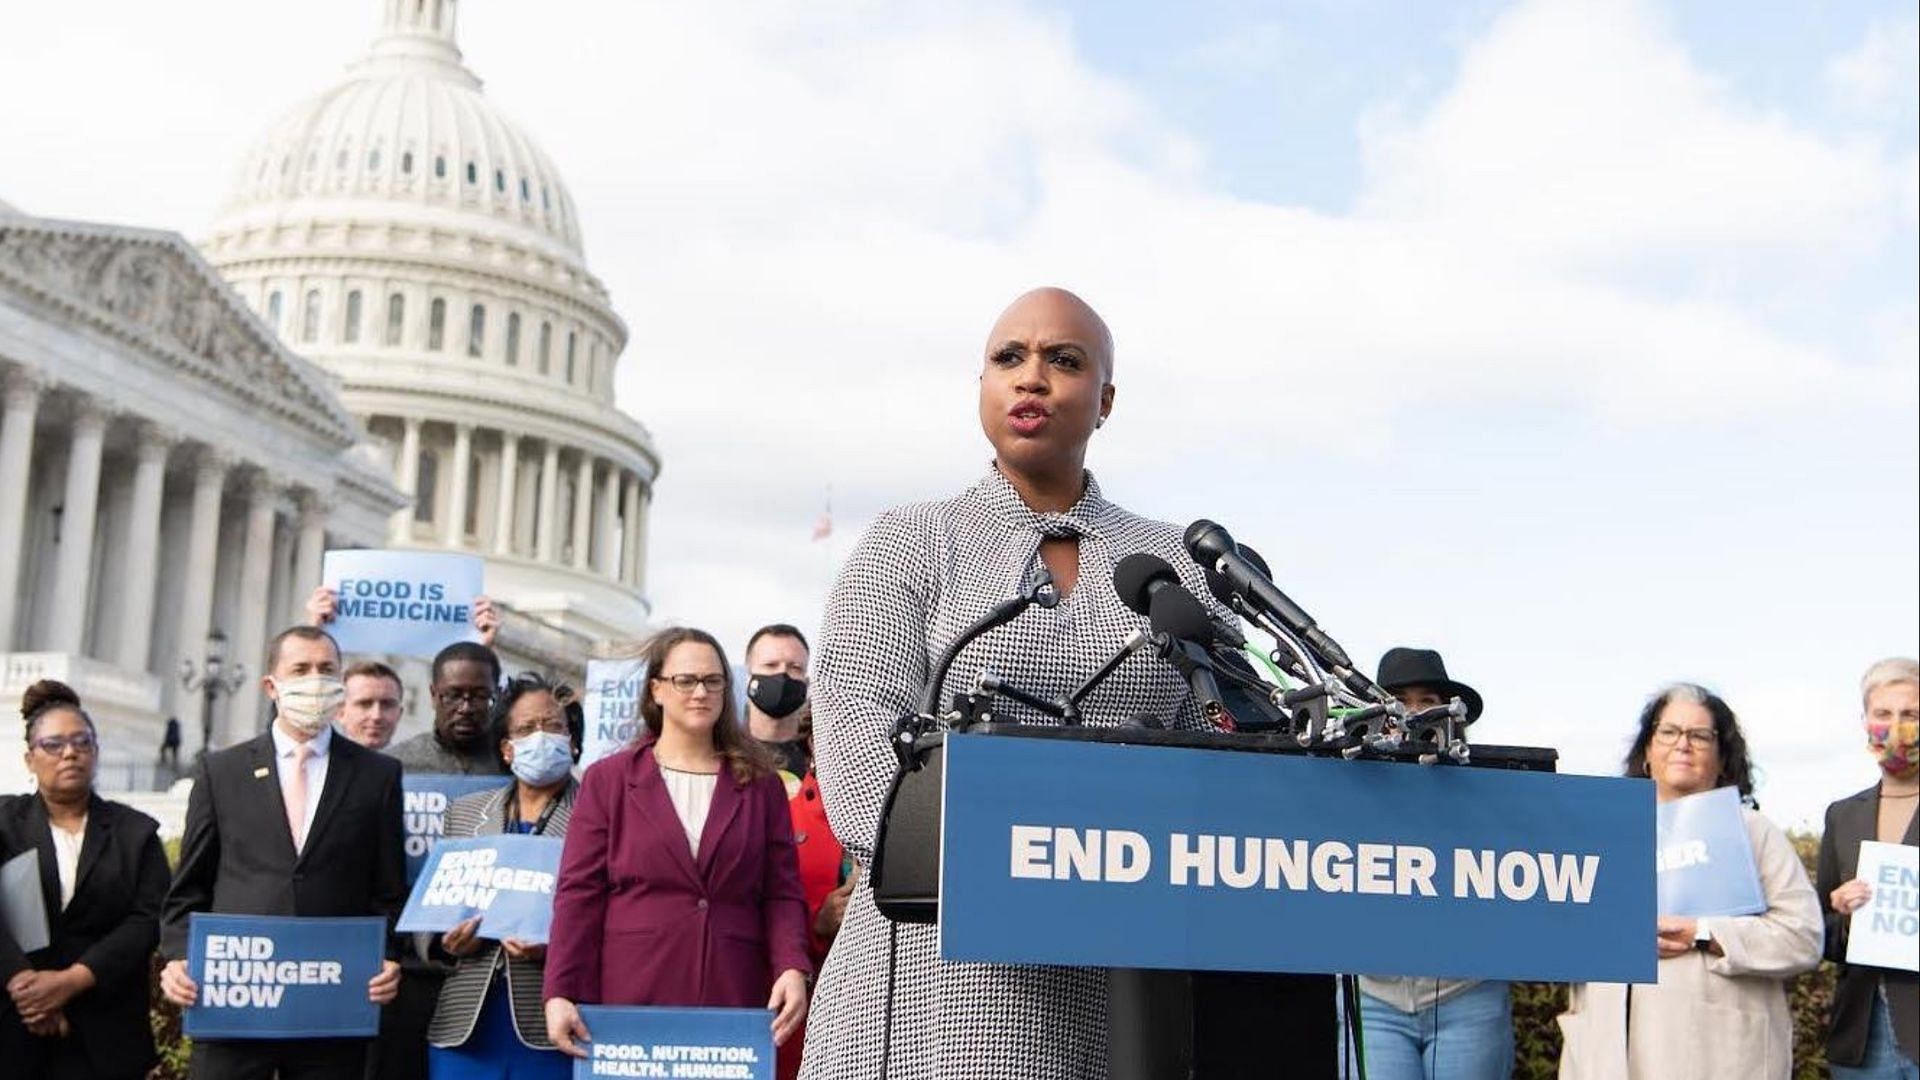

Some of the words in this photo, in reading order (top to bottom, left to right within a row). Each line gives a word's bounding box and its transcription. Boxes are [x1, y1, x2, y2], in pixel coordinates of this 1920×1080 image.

[338, 579, 411, 599] FOOD
[420, 583, 444, 601] IS
[336, 599, 469, 623] MEDICINE
[403, 813, 445, 835] UN
[438, 848, 498, 870] END
[1010, 824, 1151, 883] END
[1169, 833, 1438, 897] HUNGER
[1453, 848, 1600, 903] NOW
[430, 866, 554, 894] HUNGER
[421, 885, 498, 910] NOW
[205, 934, 274, 961] END
[204, 960, 342, 985] HUNGER
[203, 984, 285, 1009] NOW
[592, 1043, 649, 1061] FOOD.
[652, 1045, 758, 1063] NUTRITION.
[592, 1060, 669, 1077] HEALTH.
[671, 1062, 754, 1079] HUNGER.
